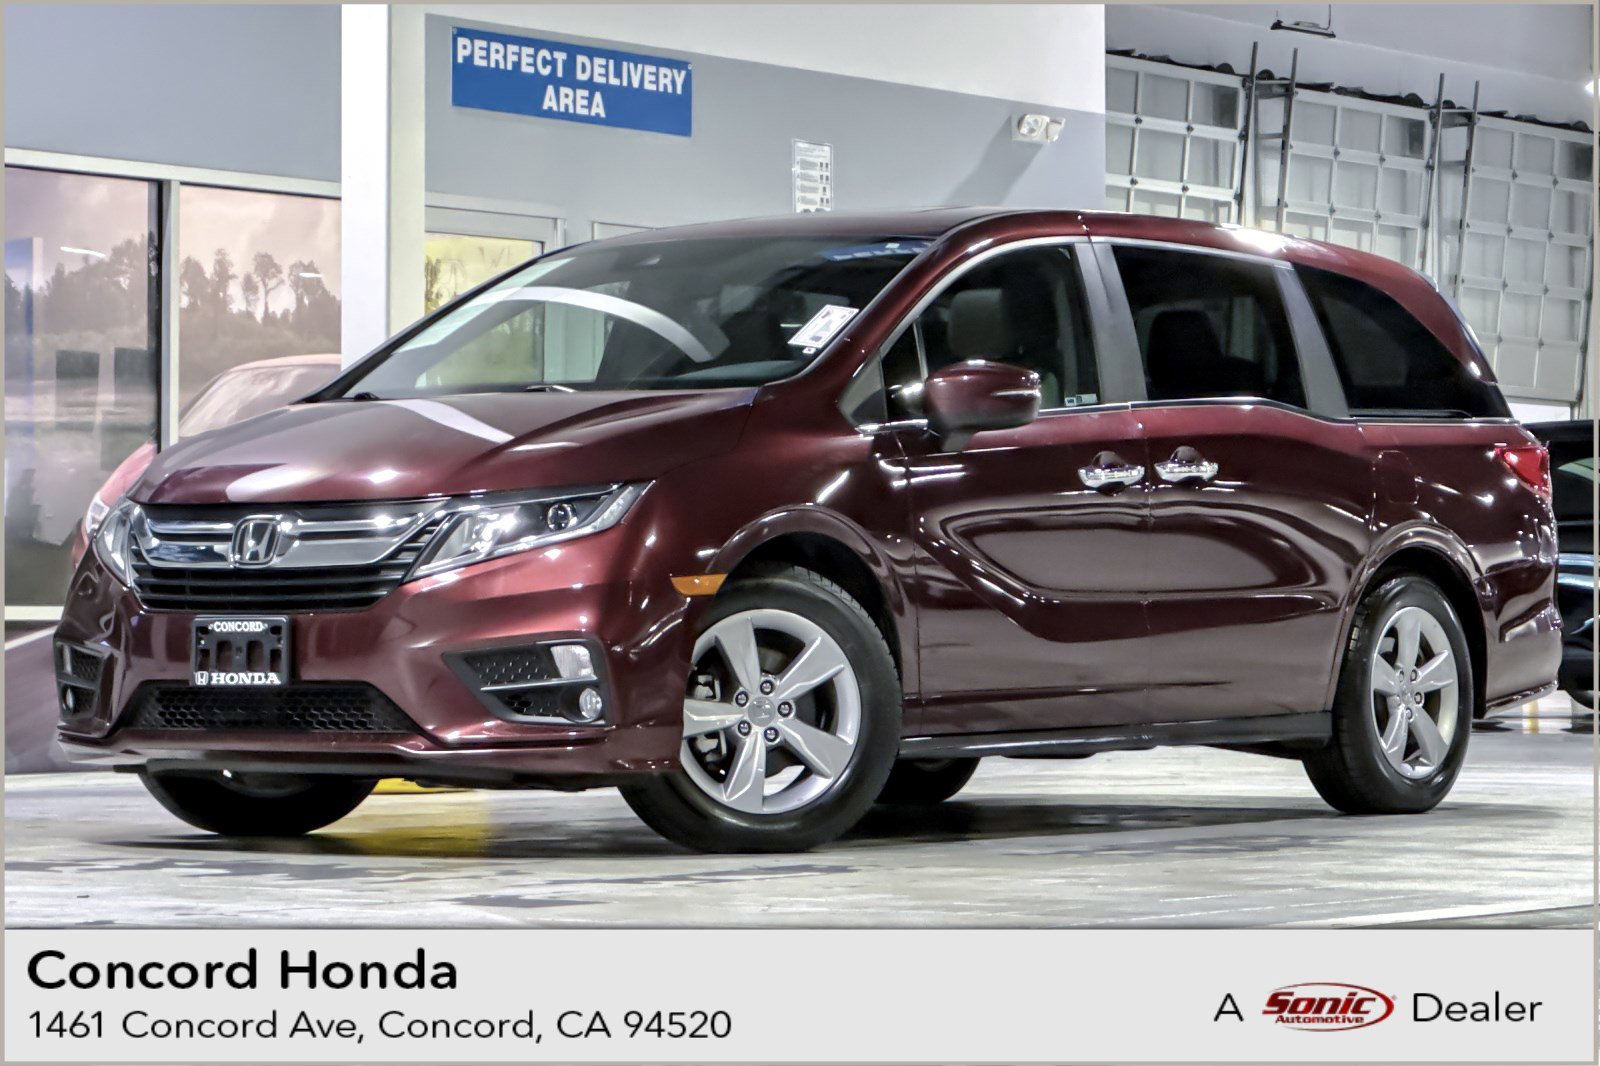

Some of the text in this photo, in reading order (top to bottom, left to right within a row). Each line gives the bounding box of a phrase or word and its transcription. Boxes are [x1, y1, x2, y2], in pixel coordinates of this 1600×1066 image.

[457, 37, 686, 95] PERFECT DELIVERY
[543, 85, 606, 118] AREA
[213, 621, 264, 632] CONCORD
[211, 672, 281, 685] HONDA
